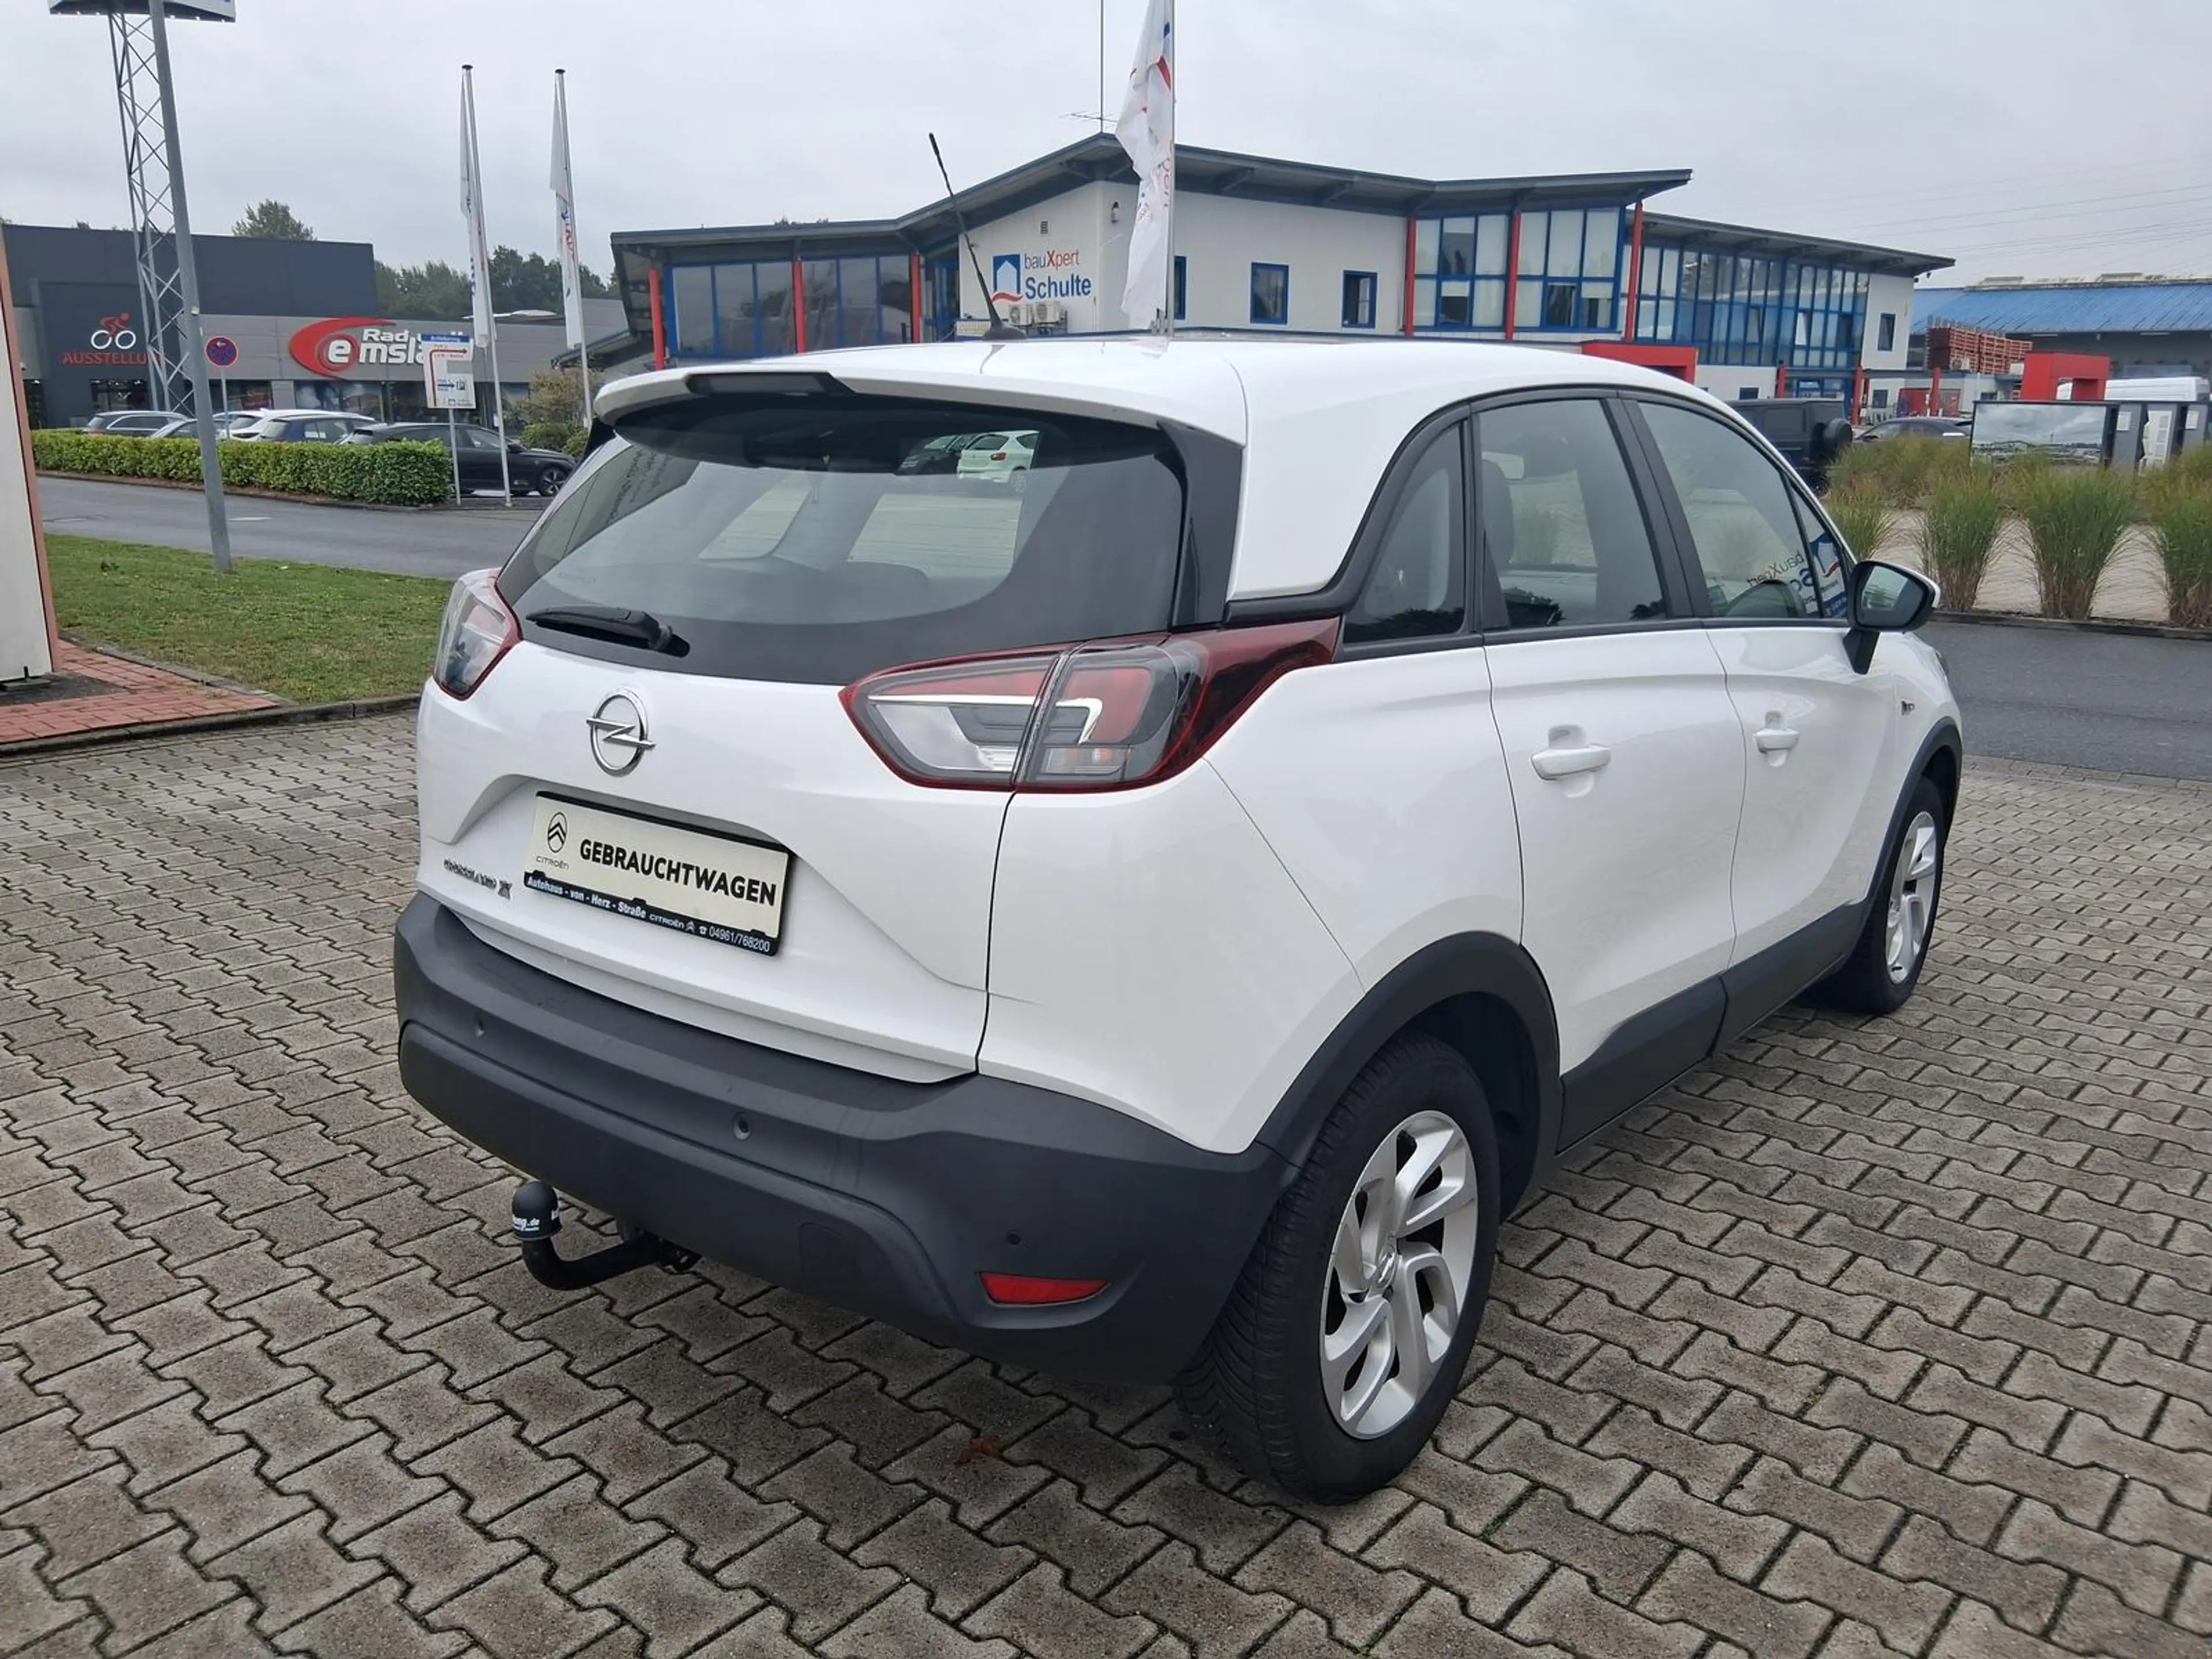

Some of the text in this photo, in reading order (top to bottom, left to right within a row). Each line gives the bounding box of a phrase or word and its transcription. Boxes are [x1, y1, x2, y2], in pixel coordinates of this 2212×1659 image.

[1024, 249, 1080, 271] bauXpert
[1025, 273, 1092, 300] Schulte
[362, 328, 409, 342] Rad
[62, 351, 166, 365] AUSSTELLU
[579, 839, 777, 907] GEBRAUCHTWAGEN
